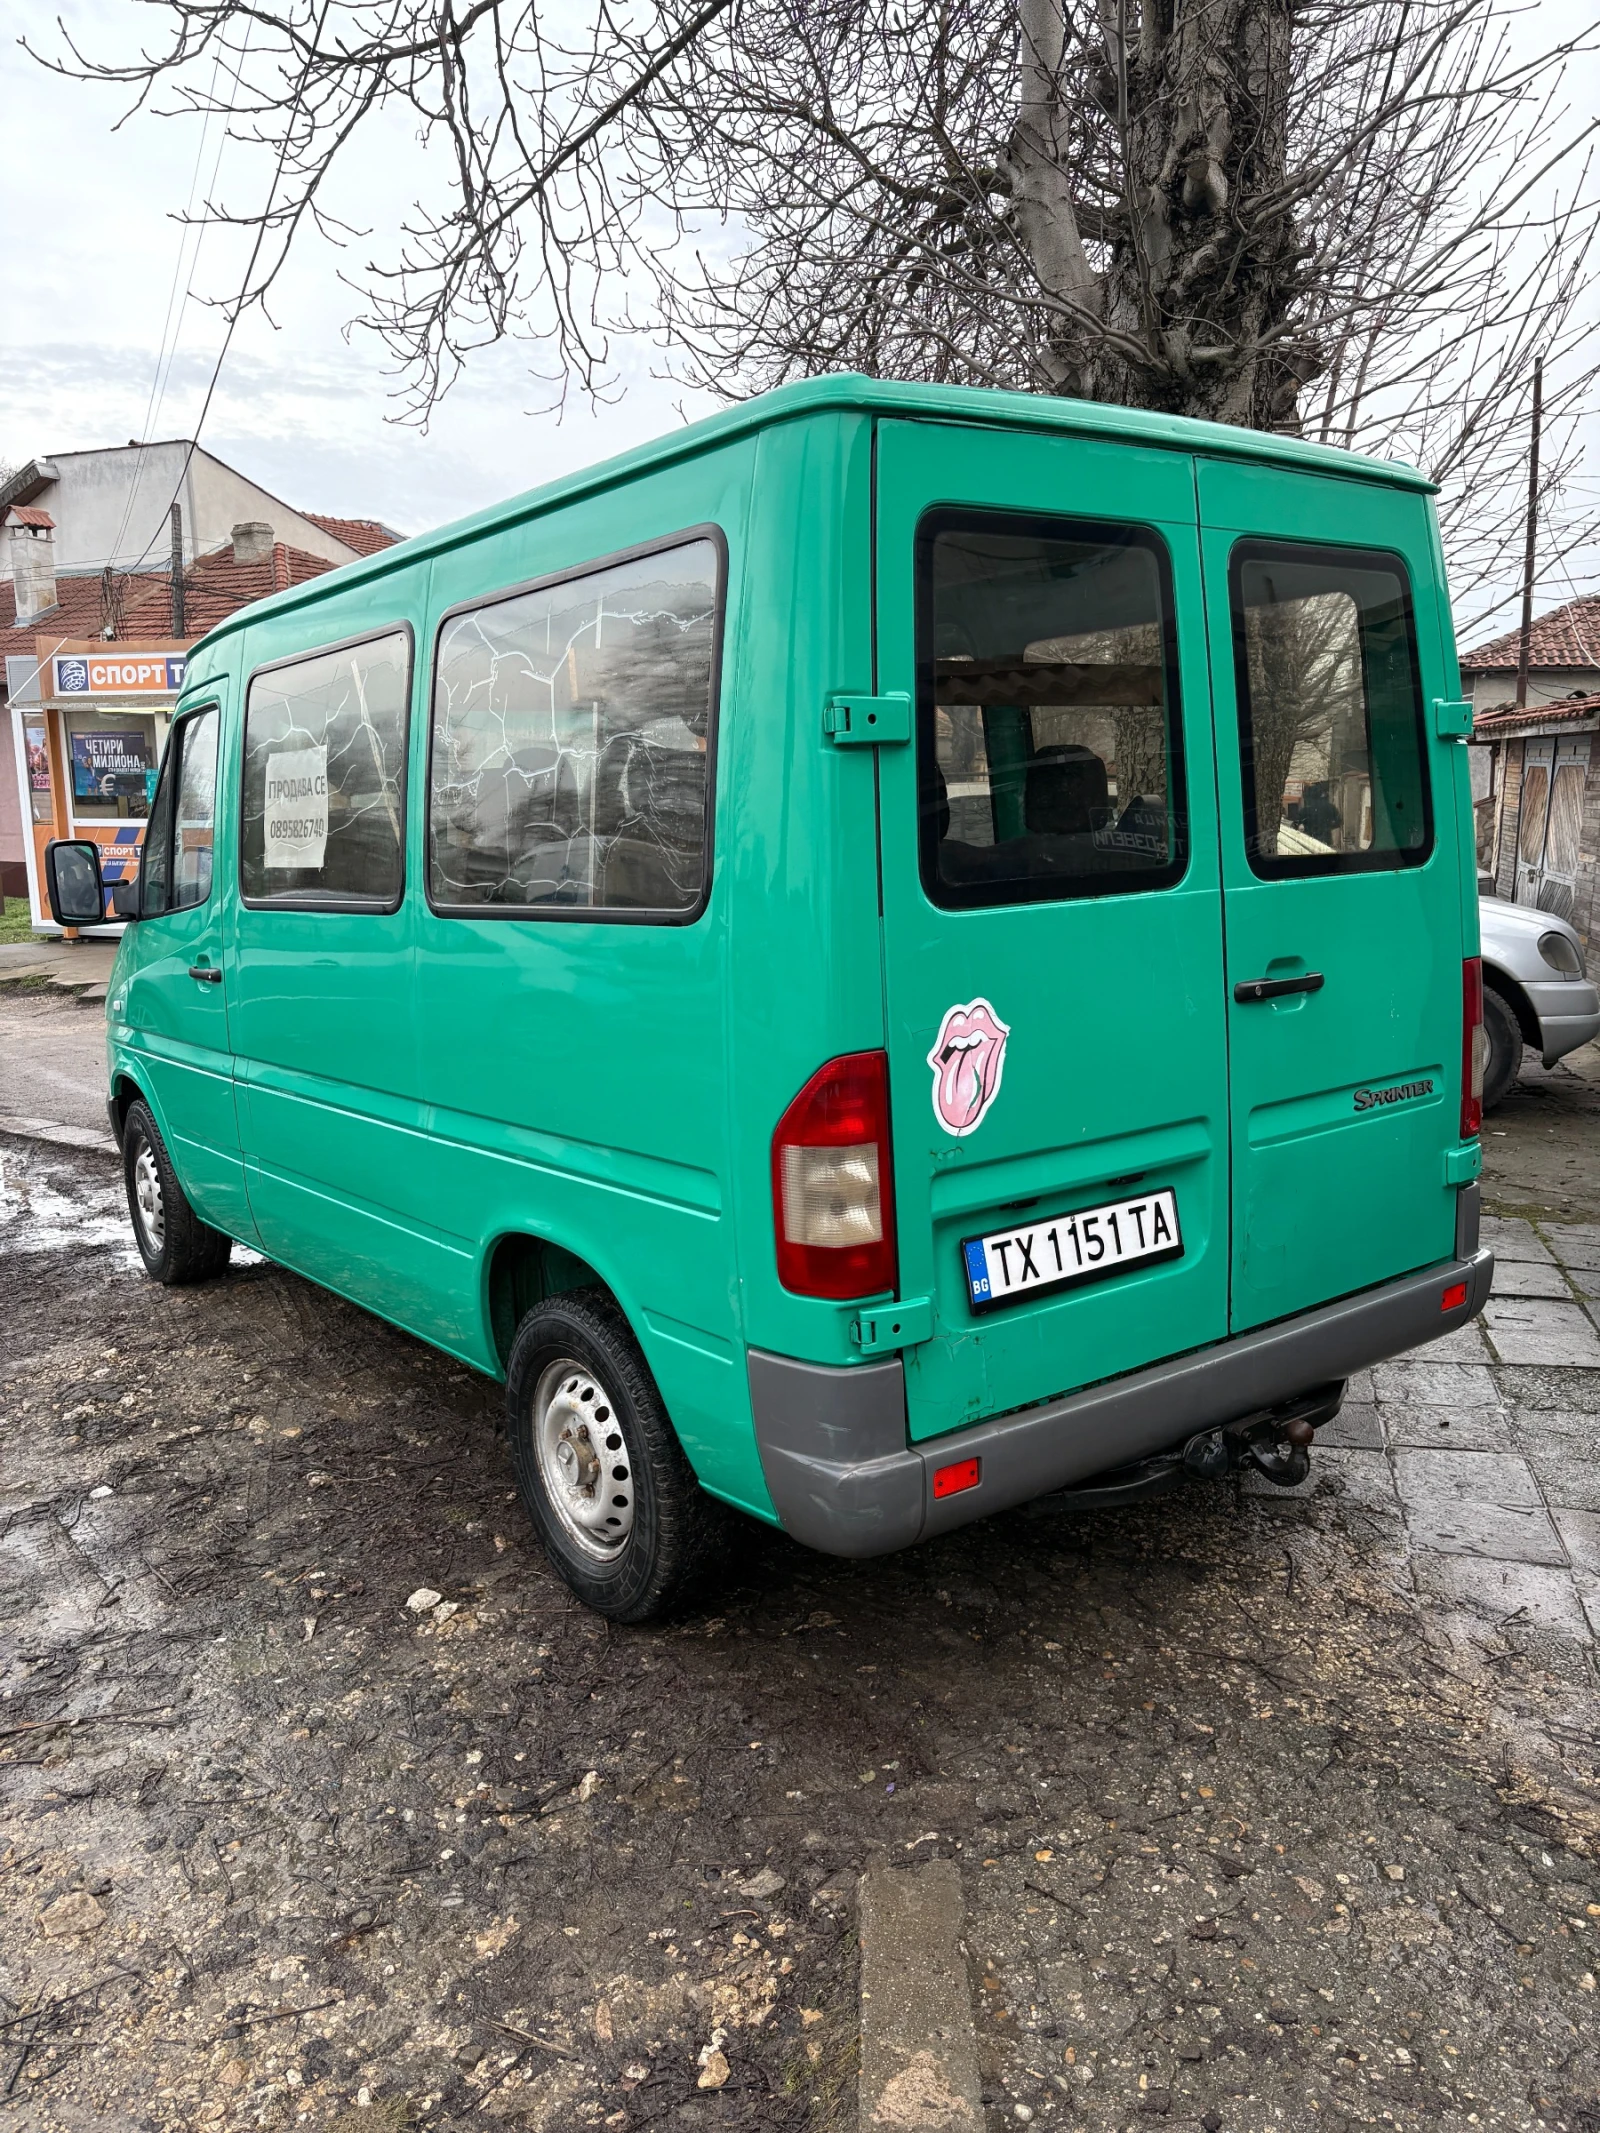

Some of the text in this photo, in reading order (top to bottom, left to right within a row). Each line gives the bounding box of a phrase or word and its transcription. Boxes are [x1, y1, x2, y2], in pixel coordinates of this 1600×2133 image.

[91, 664, 165, 685] СПОРТ
[85, 739, 124, 755] ЧЕТИРИ
[93, 754, 141, 768] МИЛИОНА
[268, 775, 326, 802] ПРОДАВА СЕ
[270, 819, 323, 838] 0895826740
[103, 848, 133, 856] СПОРТ
[1354, 1079, 1434, 1111] SPRINTER
[991, 1201, 1172, 1287] TX 1151 TA
[972, 1278, 989, 1294] BG
